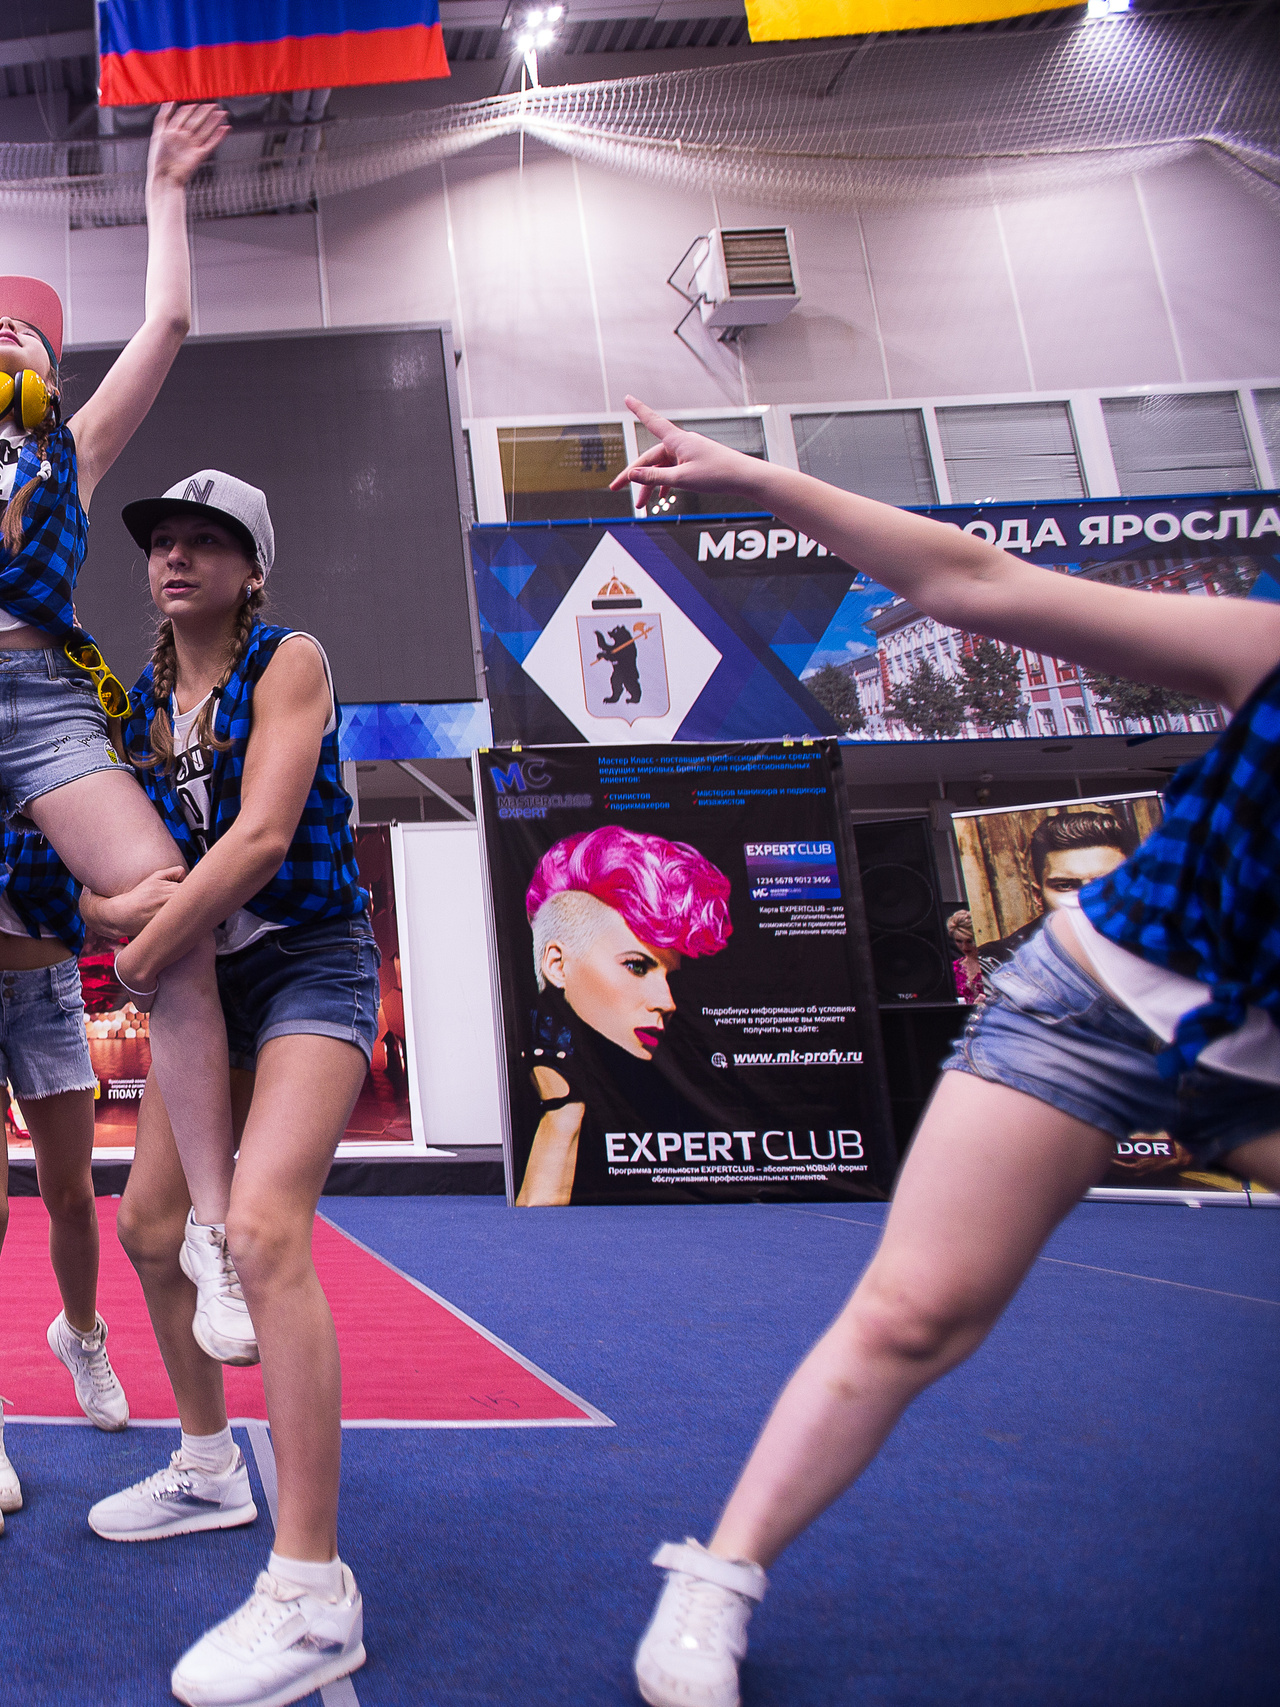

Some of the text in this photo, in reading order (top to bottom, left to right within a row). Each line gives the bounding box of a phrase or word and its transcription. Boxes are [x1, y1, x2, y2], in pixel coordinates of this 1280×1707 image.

[697, 530, 836, 563] МЭРИ
[942, 516, 1068, 554] ОДА
[598, 756, 628, 766] Мастер
[630, 756, 654, 764] Класс
[660, 756, 705, 764] поставщик
[599, 763, 810, 775] ведущих мировых брендов для профессиональных
[609, 792, 651, 801] стилистов
[610, 801, 670, 811] парикмахеров
[756, 877, 774, 885] 1234
[794, 876, 812, 884] 9012
[812, 876, 831, 884] 3456
[702, 1005, 857, 1016] Подробную информацию об условиях
[714, 1017, 747, 1027] участия
[755, 1016, 801, 1026] программе
[801, 1016, 813, 1024] вы
[814, 1015, 846, 1023] можете
[743, 1026, 781, 1036] получить
[794, 1025, 820, 1033] сайте:
[732, 1049, 864, 1066] www.mk-profy.ru
[1116, 1142, 1171, 1156] DOR
[608, 1166, 652, 1176] Программа
[653, 1166, 700, 1175] лояльности
[701, 1165, 755, 1173] EXPERTCLUB
[762, 1164, 806, 1173] абсолютно
[805, 1162, 837, 1172] НОВЫЙ
[837, 1164, 868, 1173] формат
[651, 1175, 709, 1184] обслуживания
[709, 1174, 789, 1183] профессиональных
